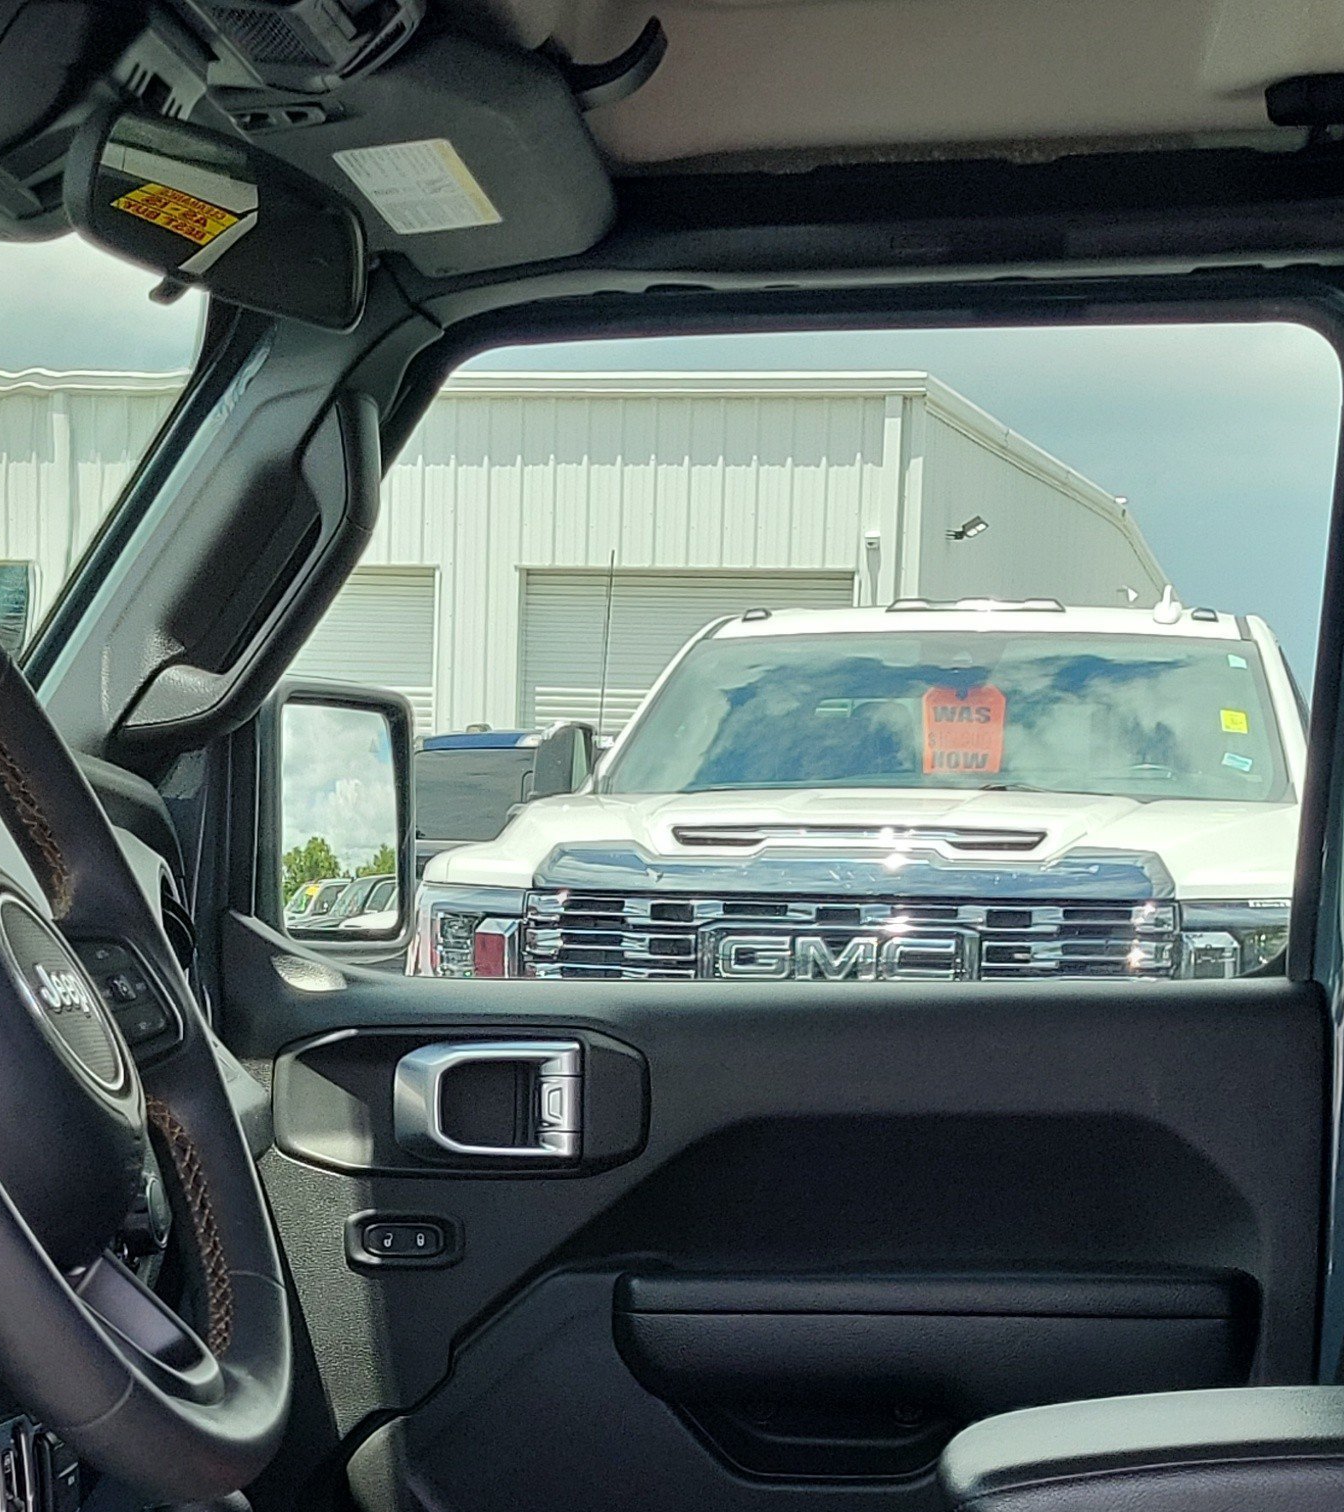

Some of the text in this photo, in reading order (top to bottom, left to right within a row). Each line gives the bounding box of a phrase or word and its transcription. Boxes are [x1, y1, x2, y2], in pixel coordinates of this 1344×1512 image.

[932, 705, 991, 724] WAS
[930, 751, 990, 769] NOW
[718, 935, 956, 981] GMC
[35, 964, 91, 1012] Jeep
